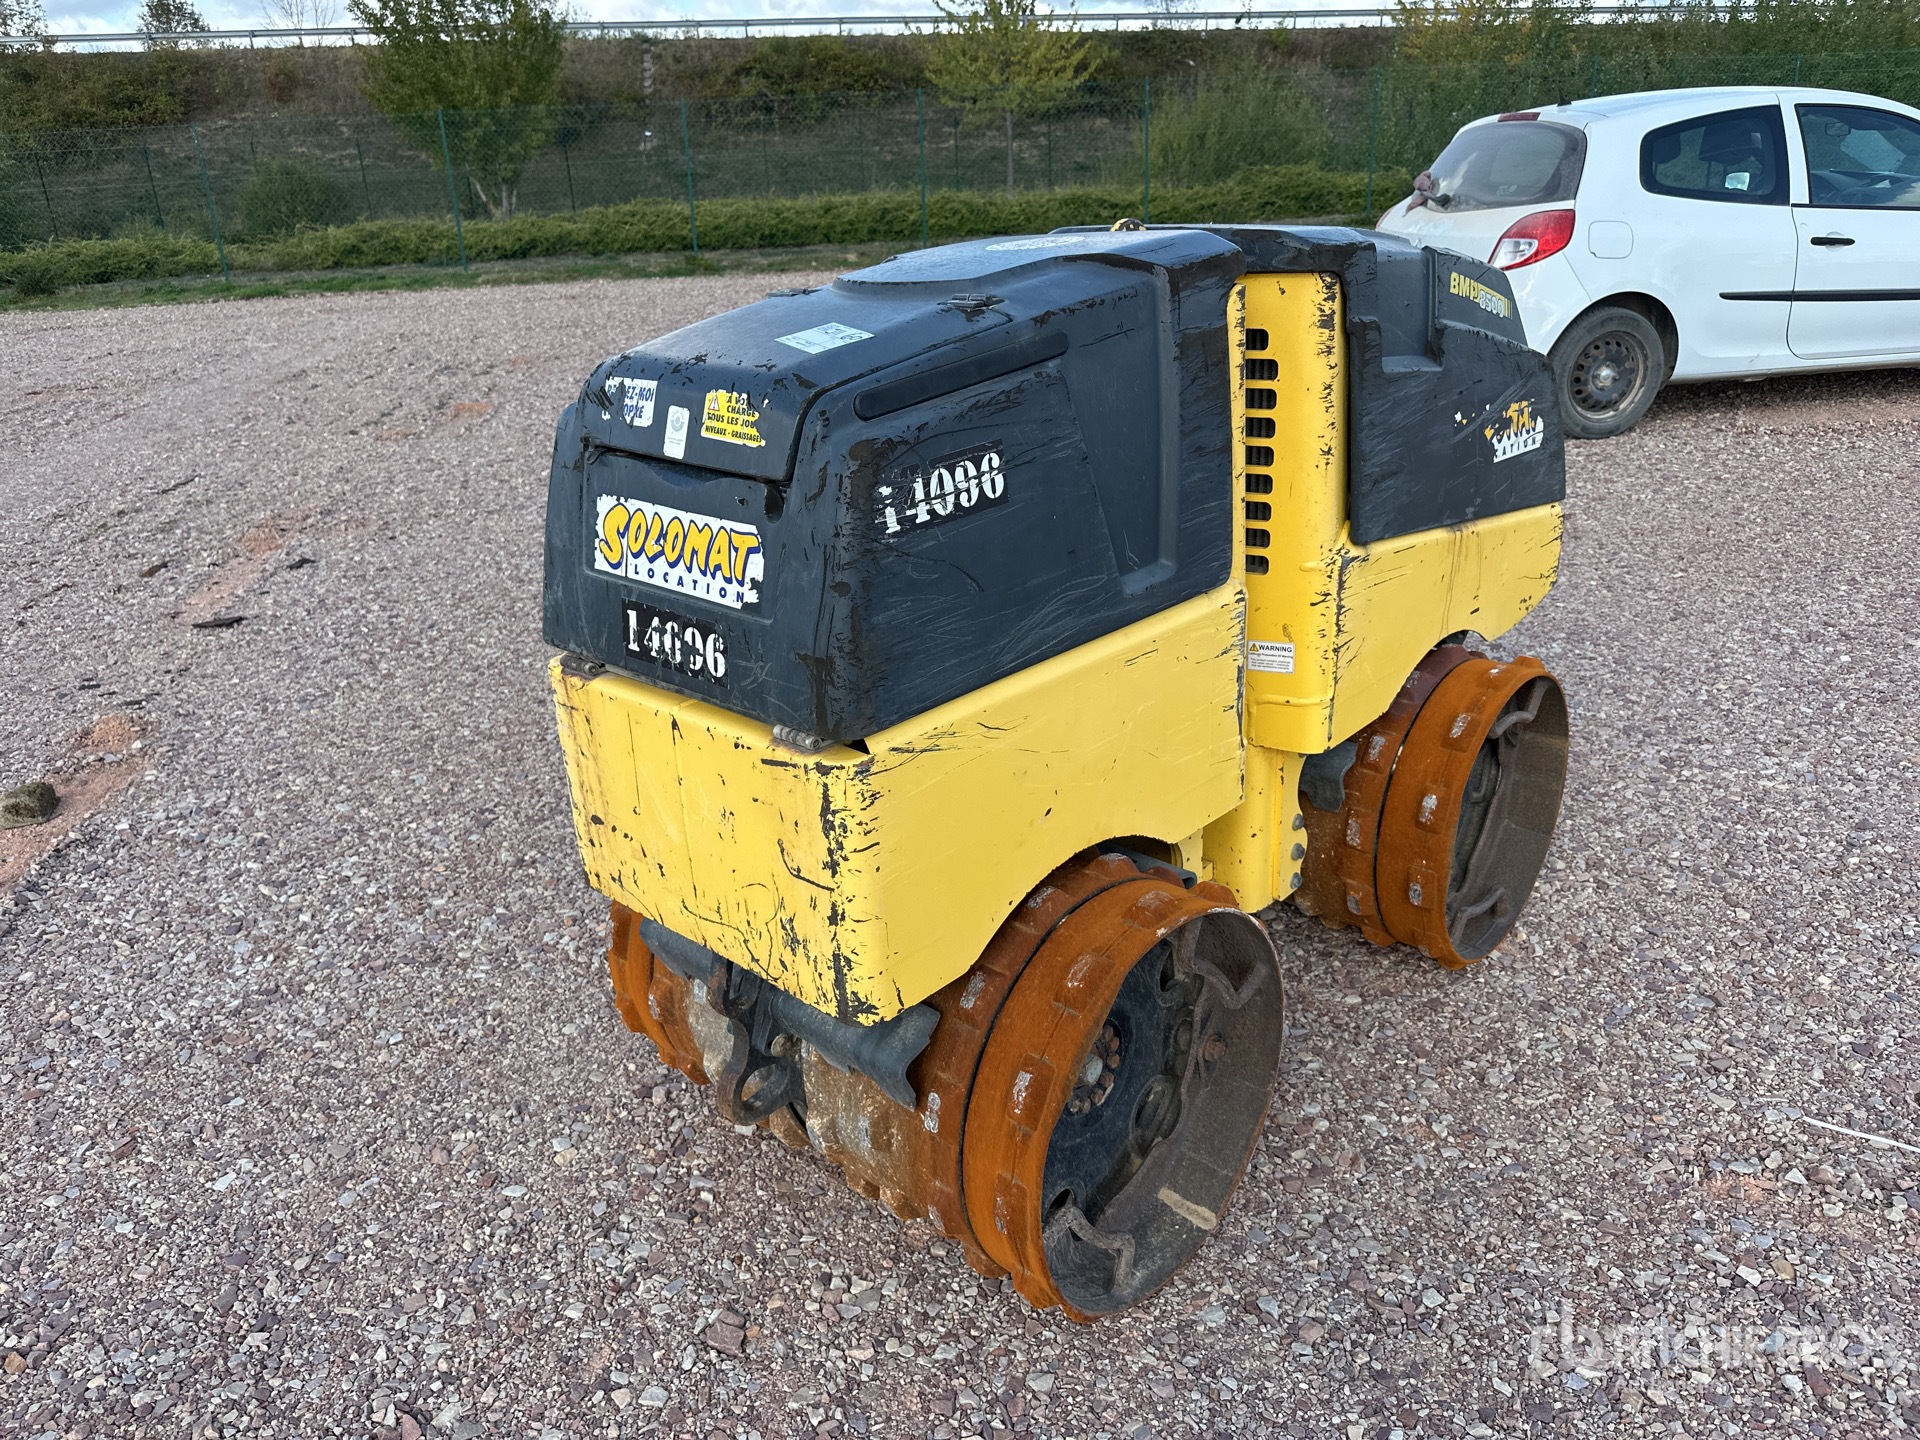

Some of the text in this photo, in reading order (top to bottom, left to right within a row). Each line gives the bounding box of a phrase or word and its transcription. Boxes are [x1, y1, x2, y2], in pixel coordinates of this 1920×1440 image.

[1450, 271, 1480, 303] BMP
[726, 405, 756, 418] CHARGE
[727, 416, 739, 426] LES
[705, 425, 727, 436] NIVEAUX
[599, 502, 762, 587] SOLOMAT
[634, 564, 745, 604] LOCATION
[1258, 644, 1292, 653] WARNING
